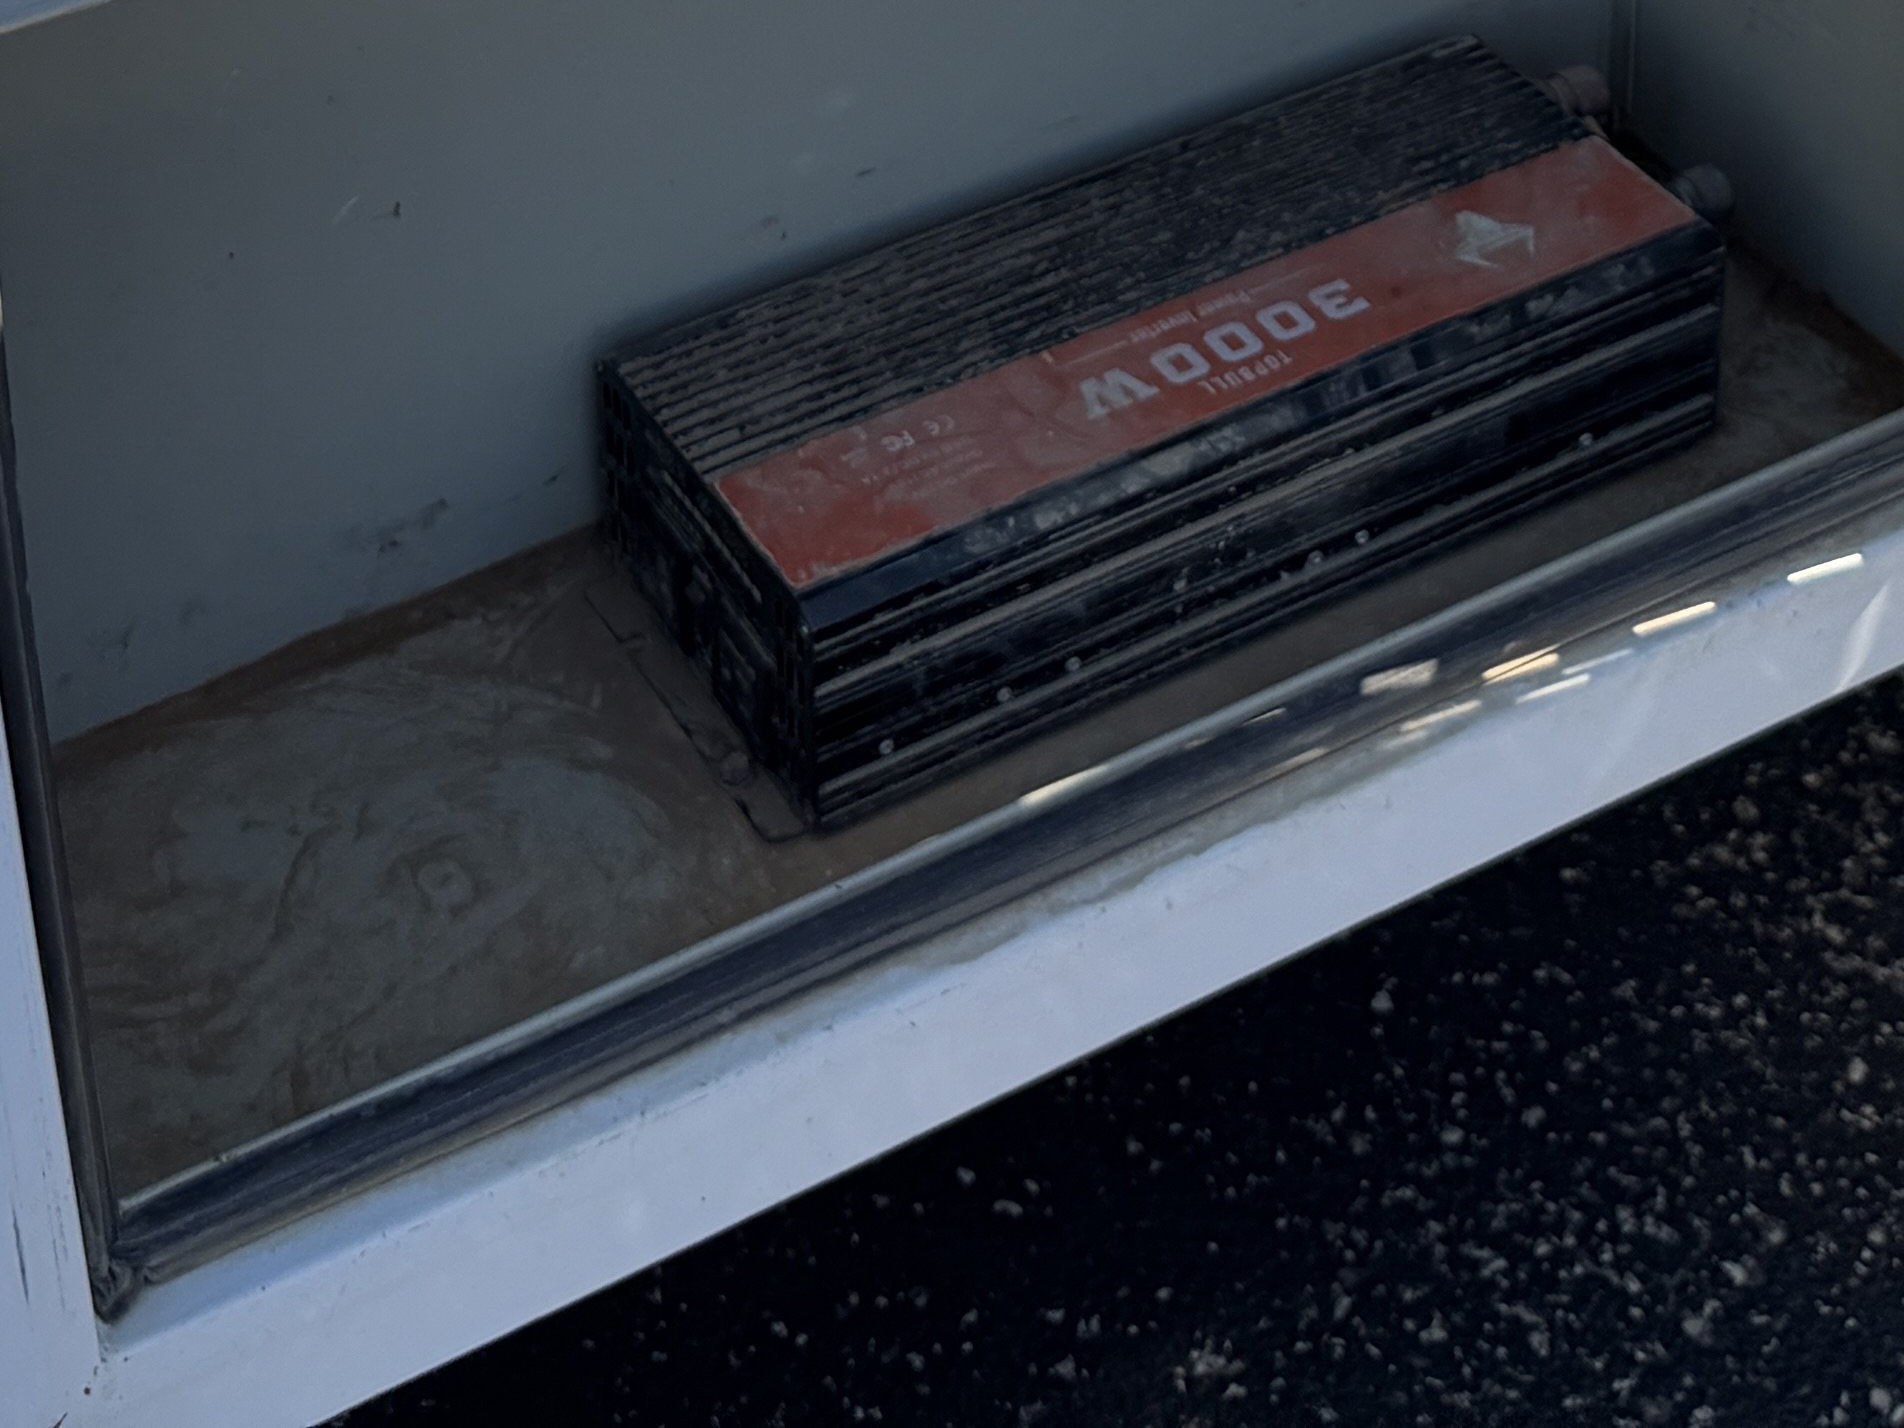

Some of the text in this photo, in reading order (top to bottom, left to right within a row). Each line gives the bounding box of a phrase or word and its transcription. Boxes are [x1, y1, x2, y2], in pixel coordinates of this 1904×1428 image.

[1129, 289, 1252, 344] Power Inverter
[1078, 278, 1371, 421] 3000W
[1198, 349, 1294, 395] TOPBULL
